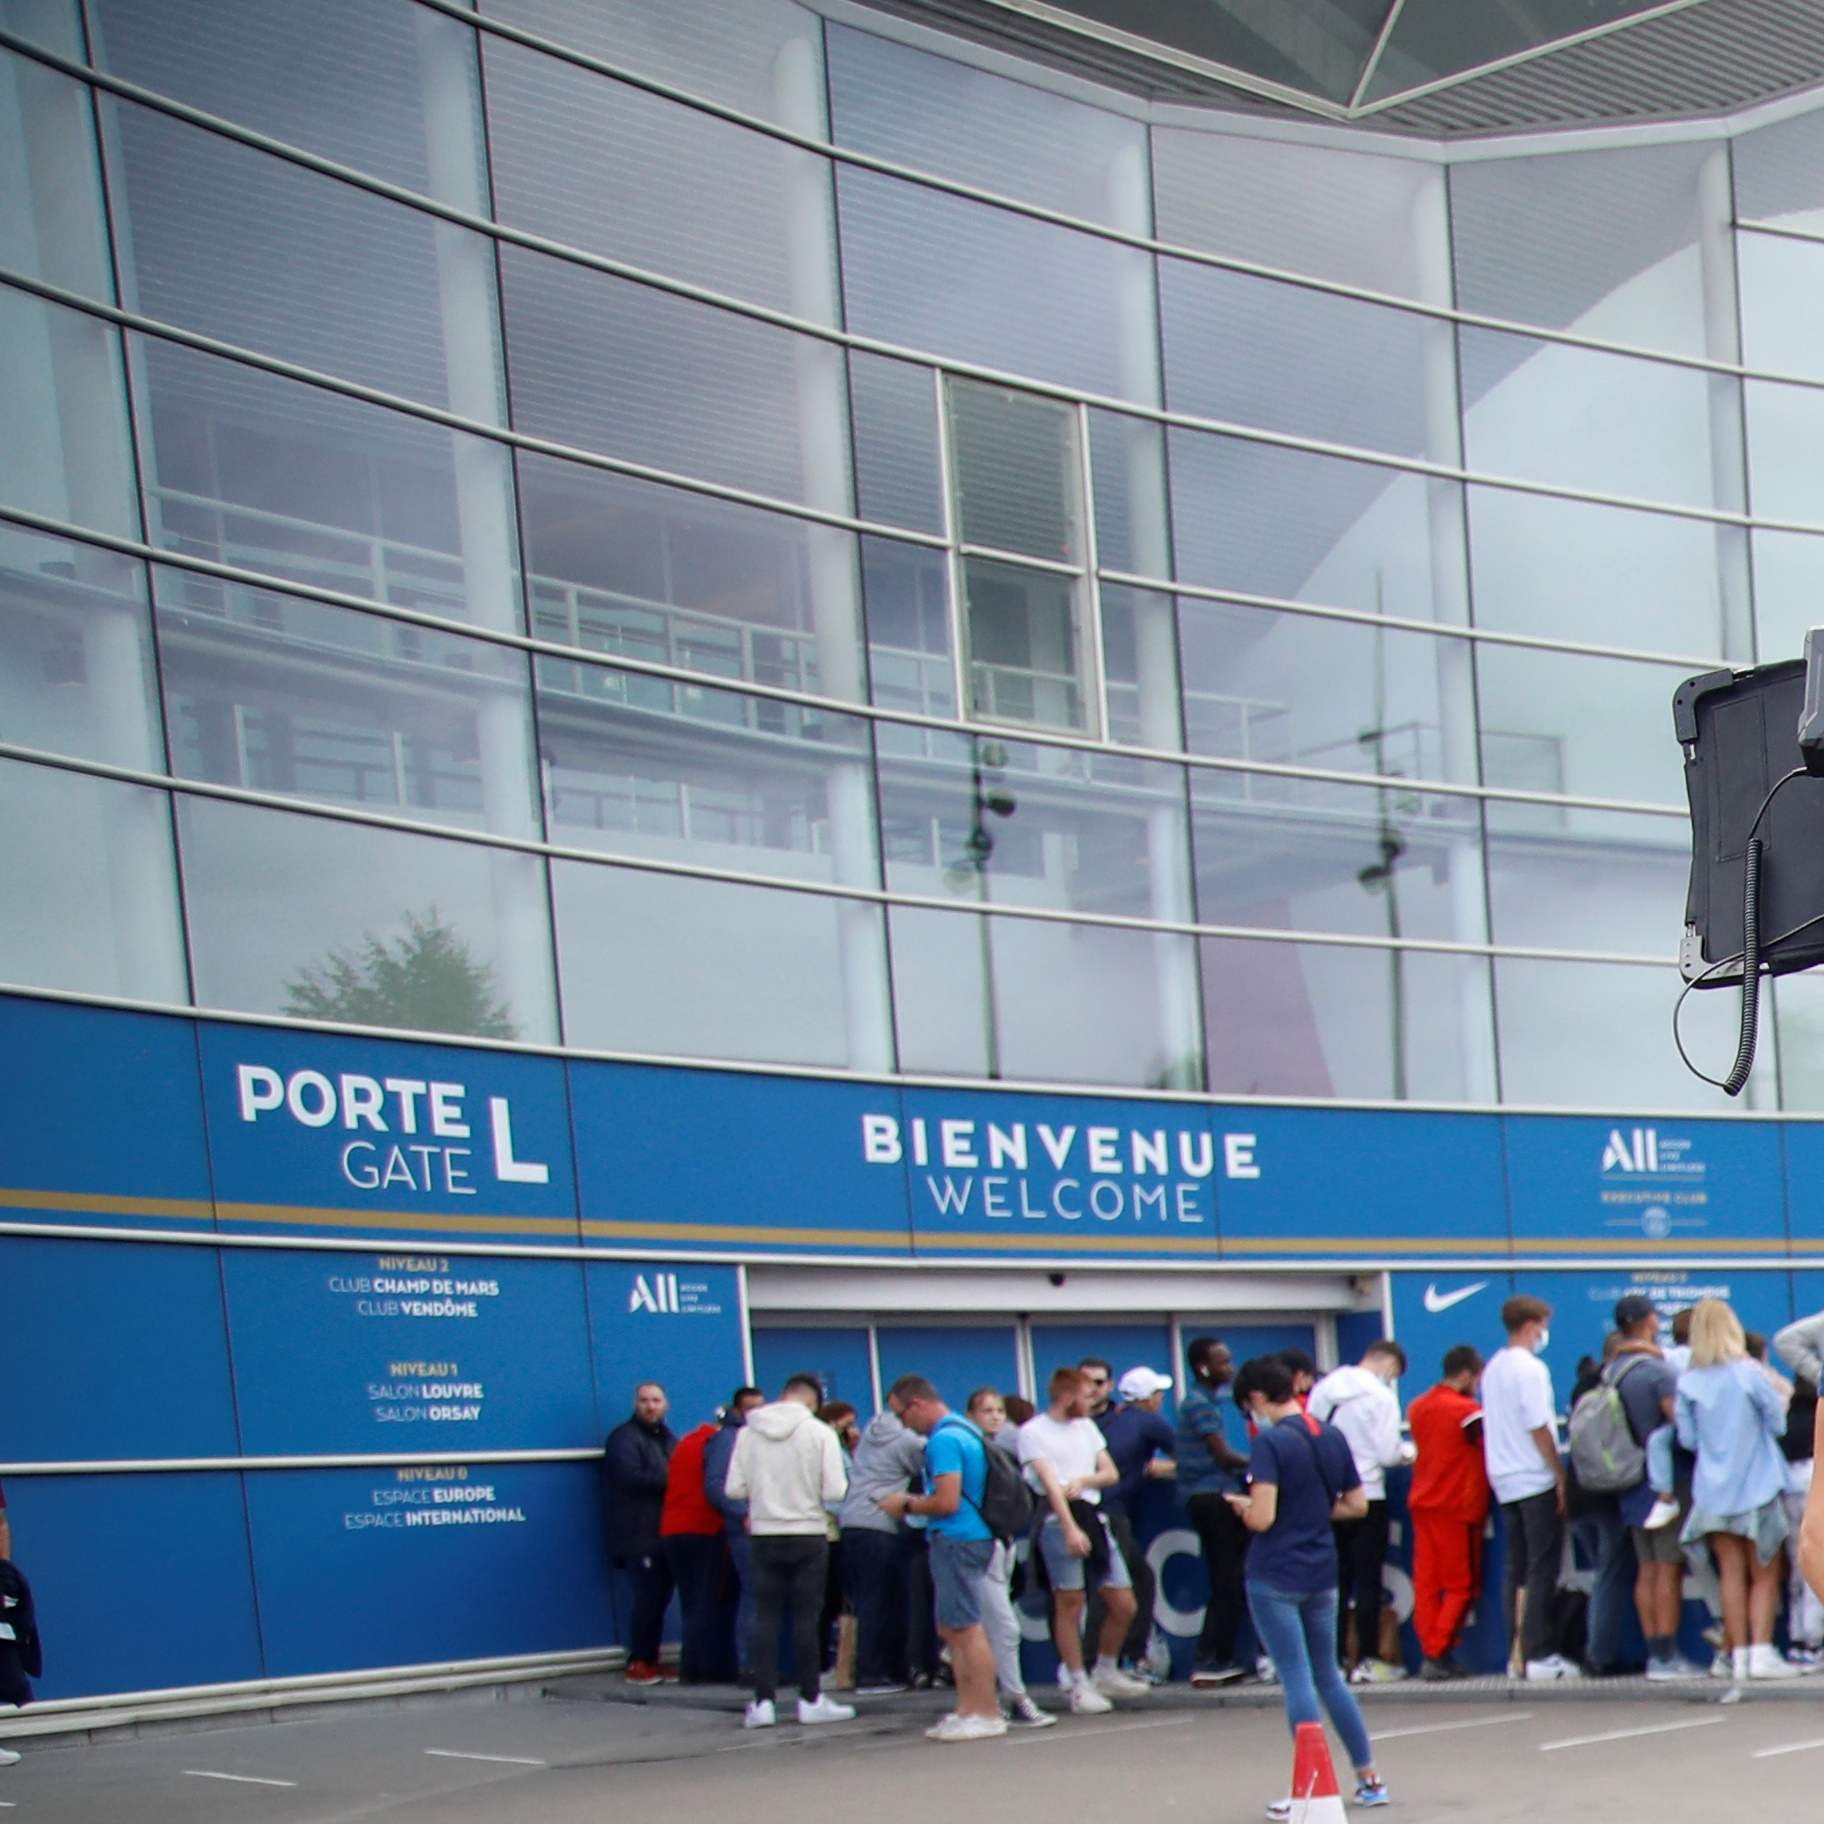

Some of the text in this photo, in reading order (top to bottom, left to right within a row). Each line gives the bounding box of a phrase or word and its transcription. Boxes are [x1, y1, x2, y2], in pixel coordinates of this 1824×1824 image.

[237, 1064, 549, 1184] PORTE L
[862, 1114, 1260, 1179] BIENVENUE
[342, 1141, 477, 1194] GATE
[926, 1175, 1204, 1222] WELCOME
[379, 1257, 449, 1272] NIVEAU 2
[329, 1277, 499, 1296] CLUB CHAMP DE MARS
[358, 1299, 478, 1317] CLUB VENDÔME
[389, 1362, 448, 1376] NIVEAU
[368, 1383, 484, 1400] SALON LOUVRE
[376, 1405, 481, 1422] SALON ORSAY
[397, 1467, 455, 1481] NIVEAU
[373, 1486, 496, 1506] ESPACE EUROPE
[345, 1507, 526, 1529] ESPACE INTERNATIONAL
